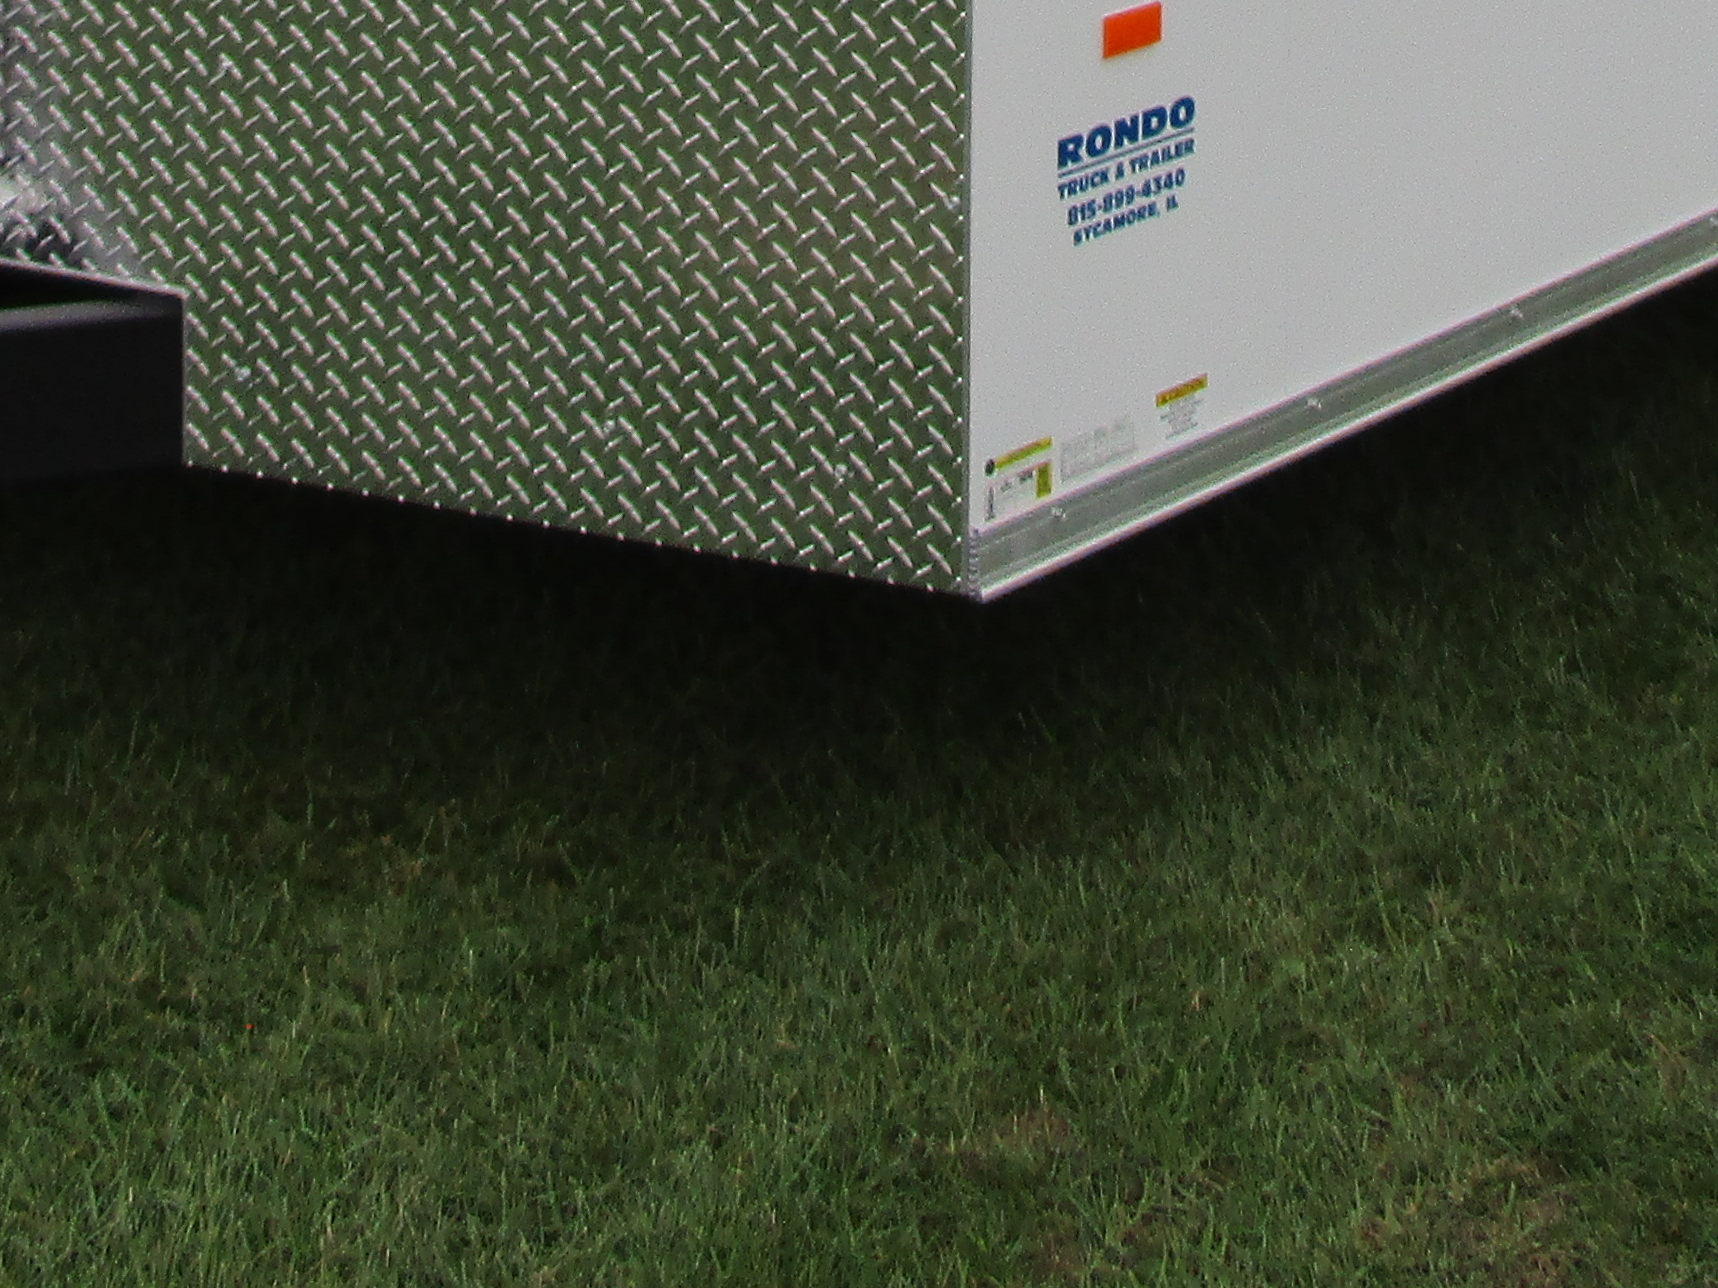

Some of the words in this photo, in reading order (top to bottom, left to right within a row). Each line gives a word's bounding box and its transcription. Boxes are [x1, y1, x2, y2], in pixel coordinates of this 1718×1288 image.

[1057, 95, 1196, 170] RONDO
[1057, 166, 1110, 200] TRUCK
[1114, 161, 1125, 181] &
[1128, 137, 1196, 174] TRAILER
